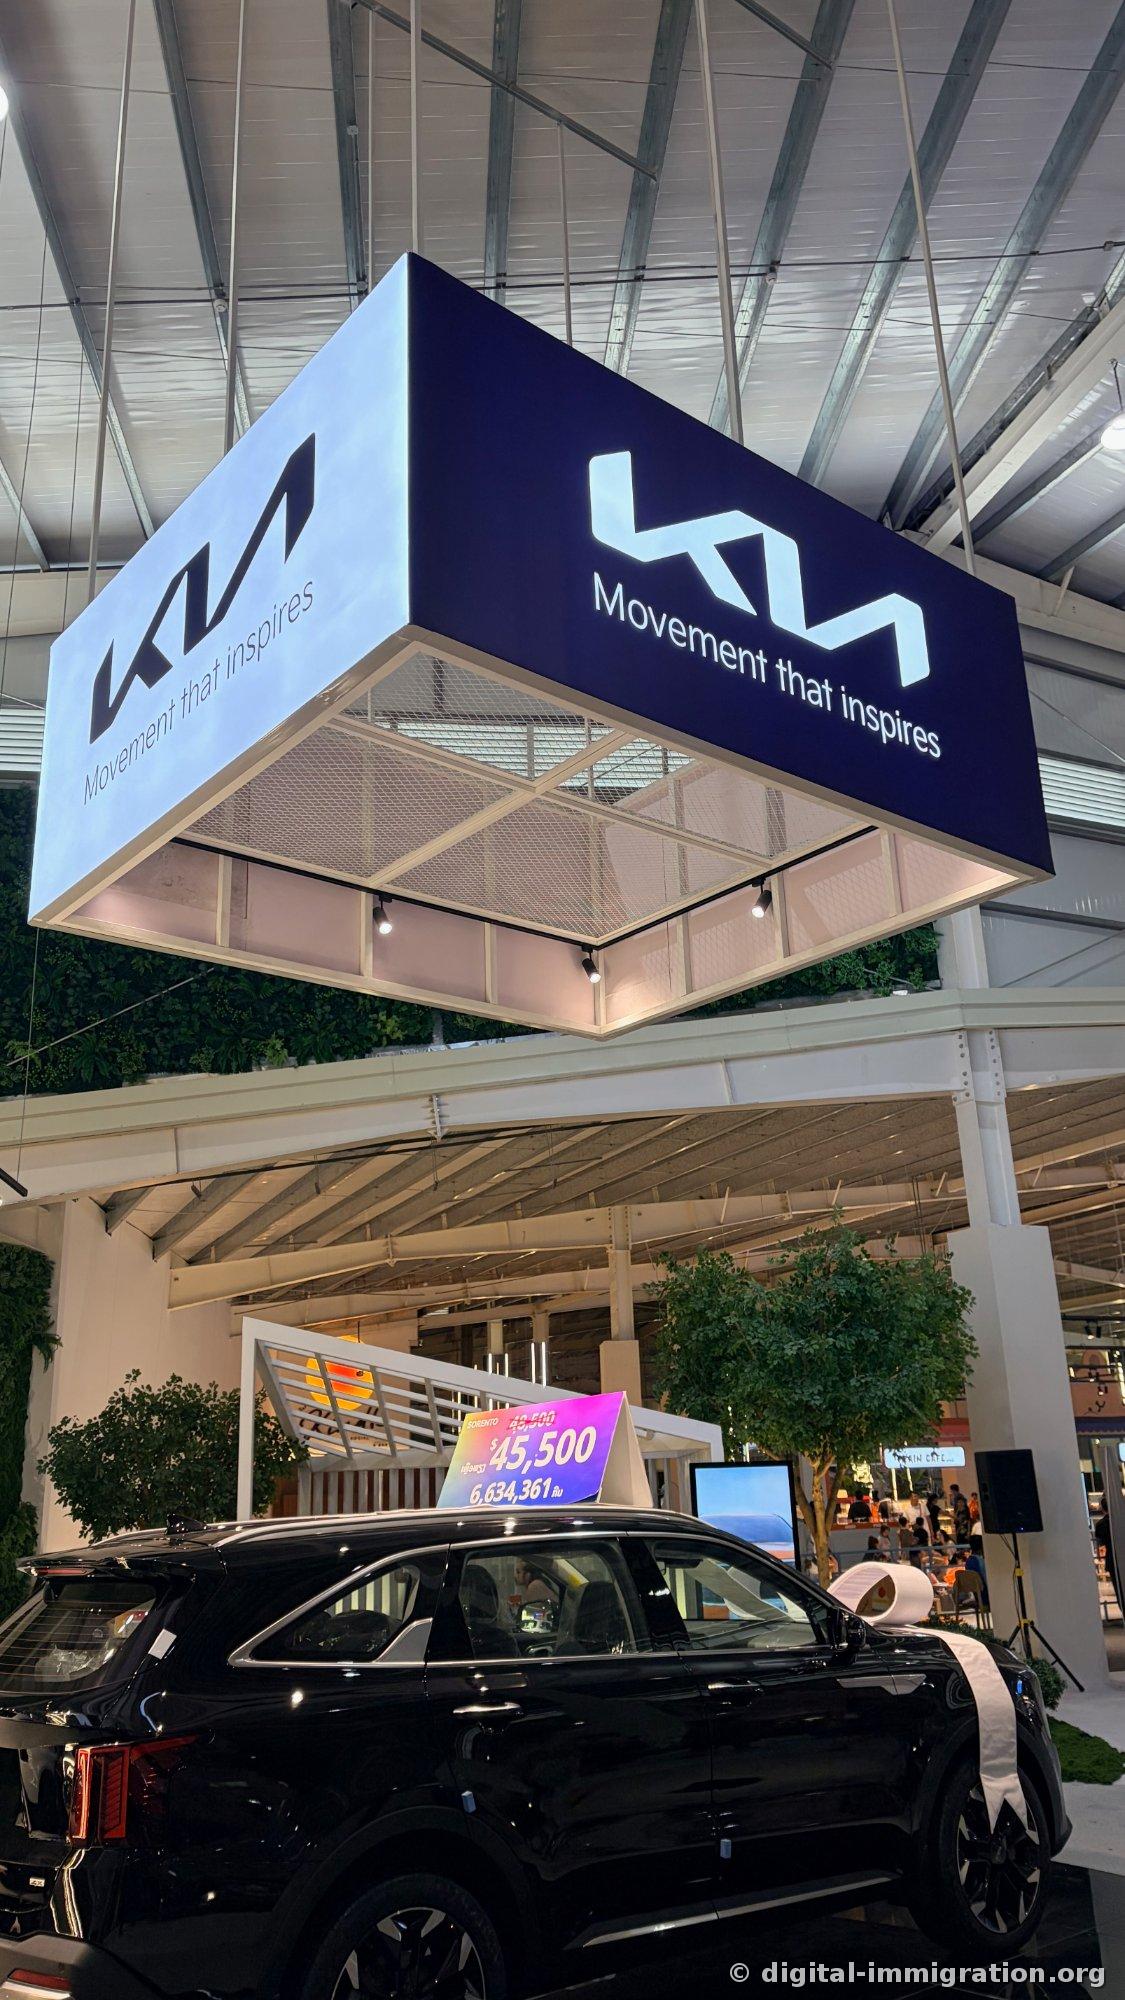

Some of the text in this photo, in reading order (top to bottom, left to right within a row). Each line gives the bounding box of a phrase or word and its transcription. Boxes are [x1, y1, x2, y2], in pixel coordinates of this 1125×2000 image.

[84, 581, 314, 806] Movement that inspires
[593, 571, 942, 759] Movement that inspires
[467, 1417, 499, 1430] SORENTO
[469, 1477, 552, 1505] 6,634,361
